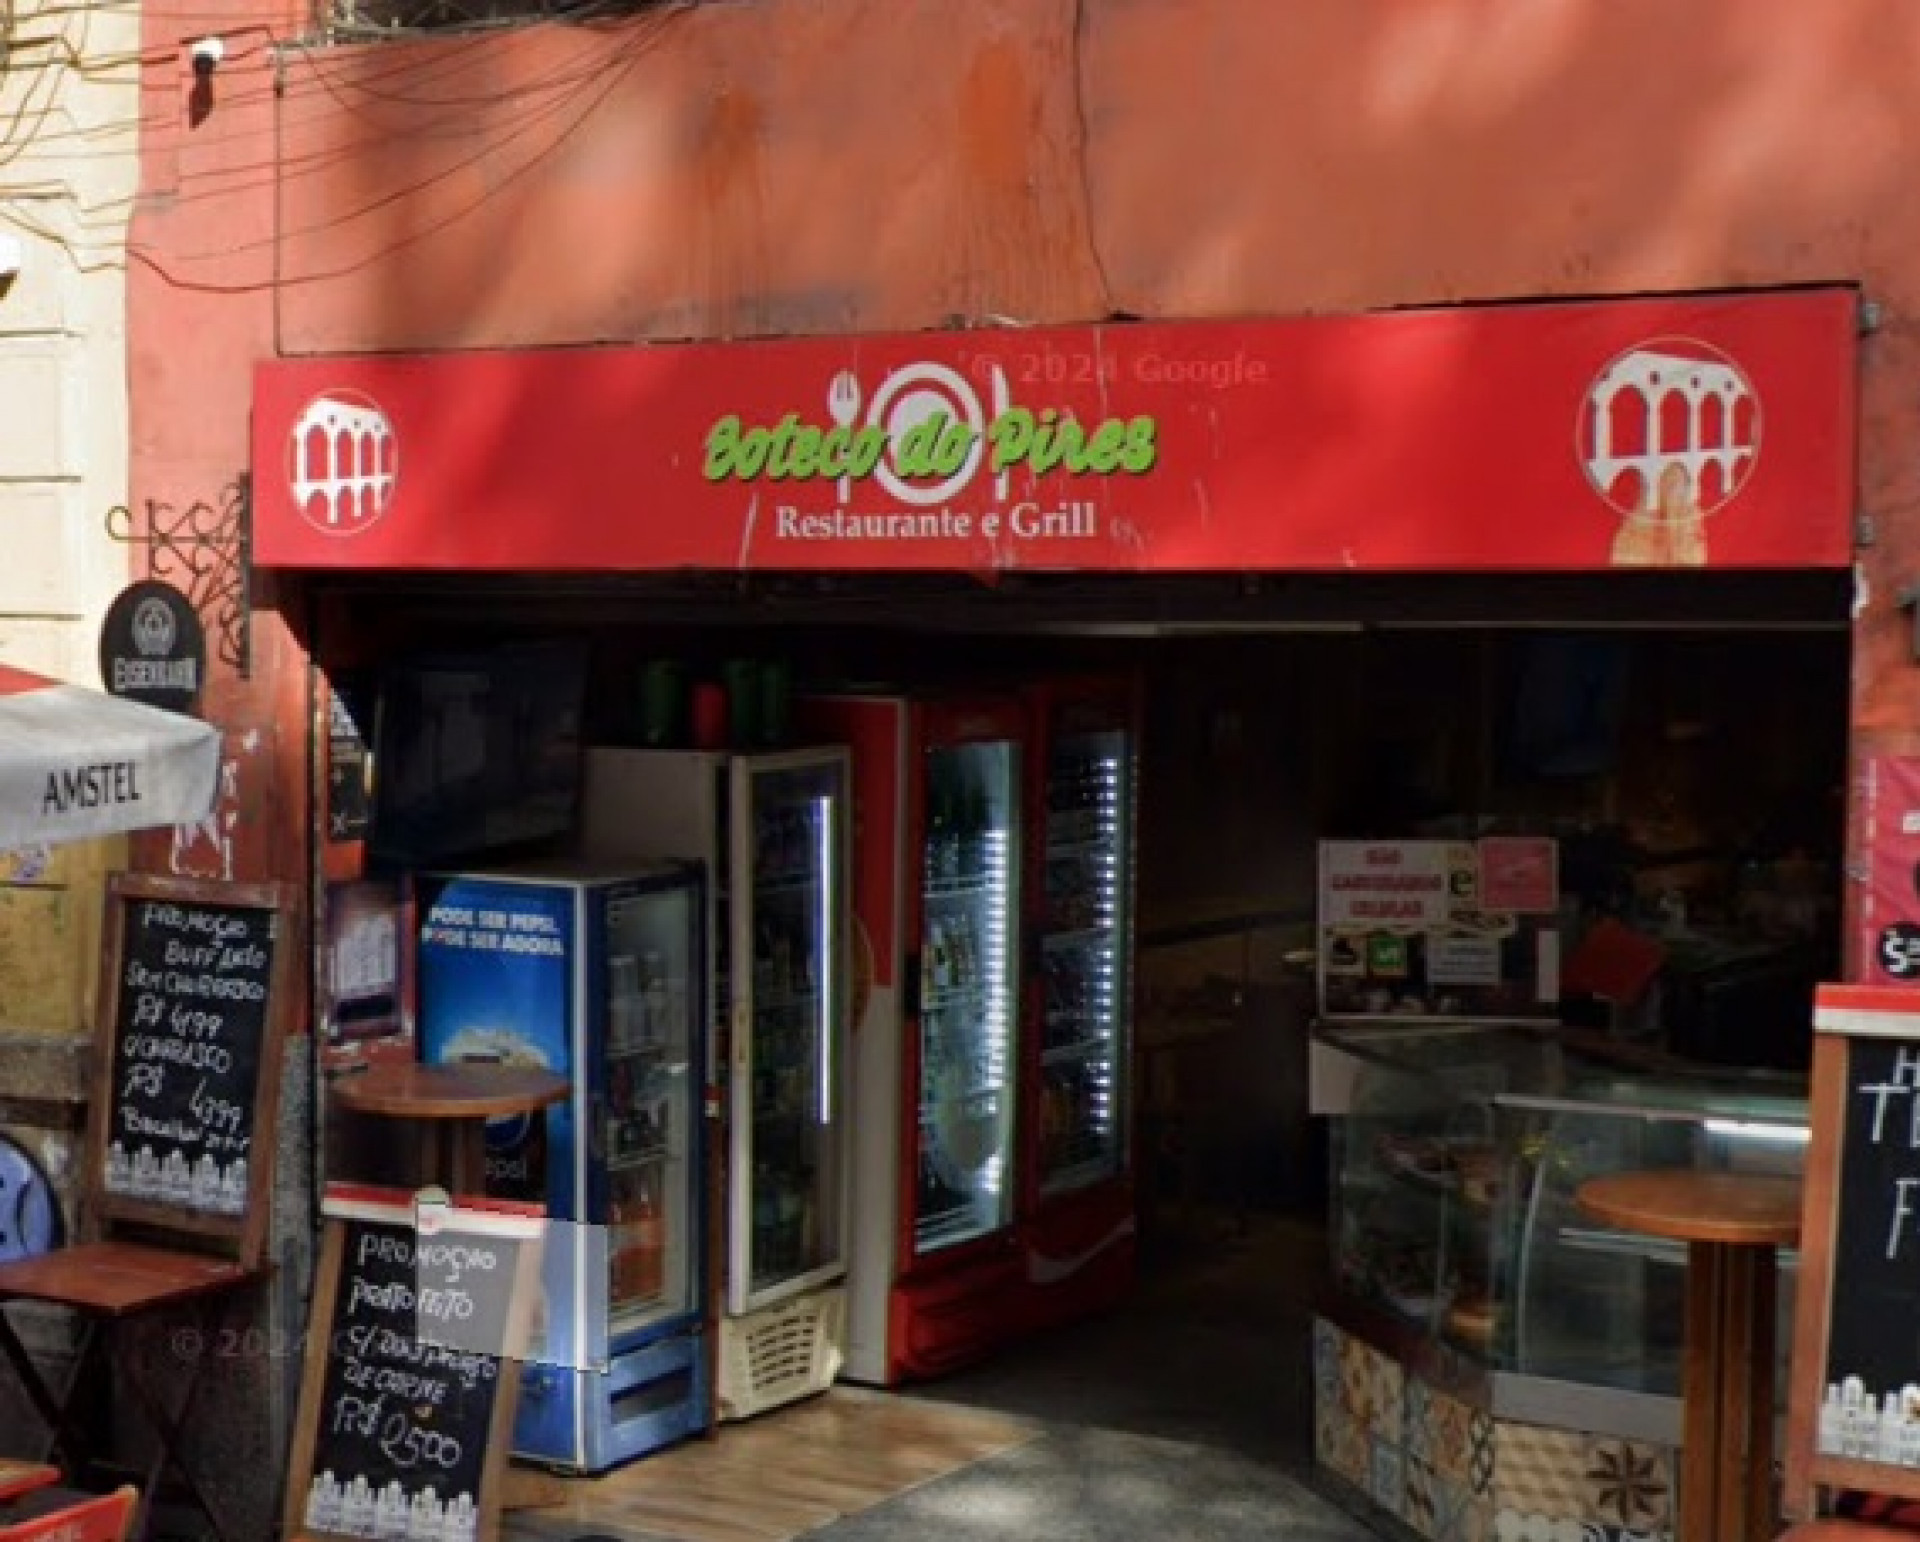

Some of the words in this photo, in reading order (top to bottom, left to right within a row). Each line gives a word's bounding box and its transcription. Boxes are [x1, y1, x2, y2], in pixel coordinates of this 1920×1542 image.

[704, 414, 888, 481] Boteco
[893, 410, 980, 480] do
[990, 407, 1158, 476] Pires
[776, 505, 972, 539] Restaurante
[980, 515, 1000, 539] e
[1010, 502, 1096, 538] Grill
[42, 760, 142, 816] AMSTEL
